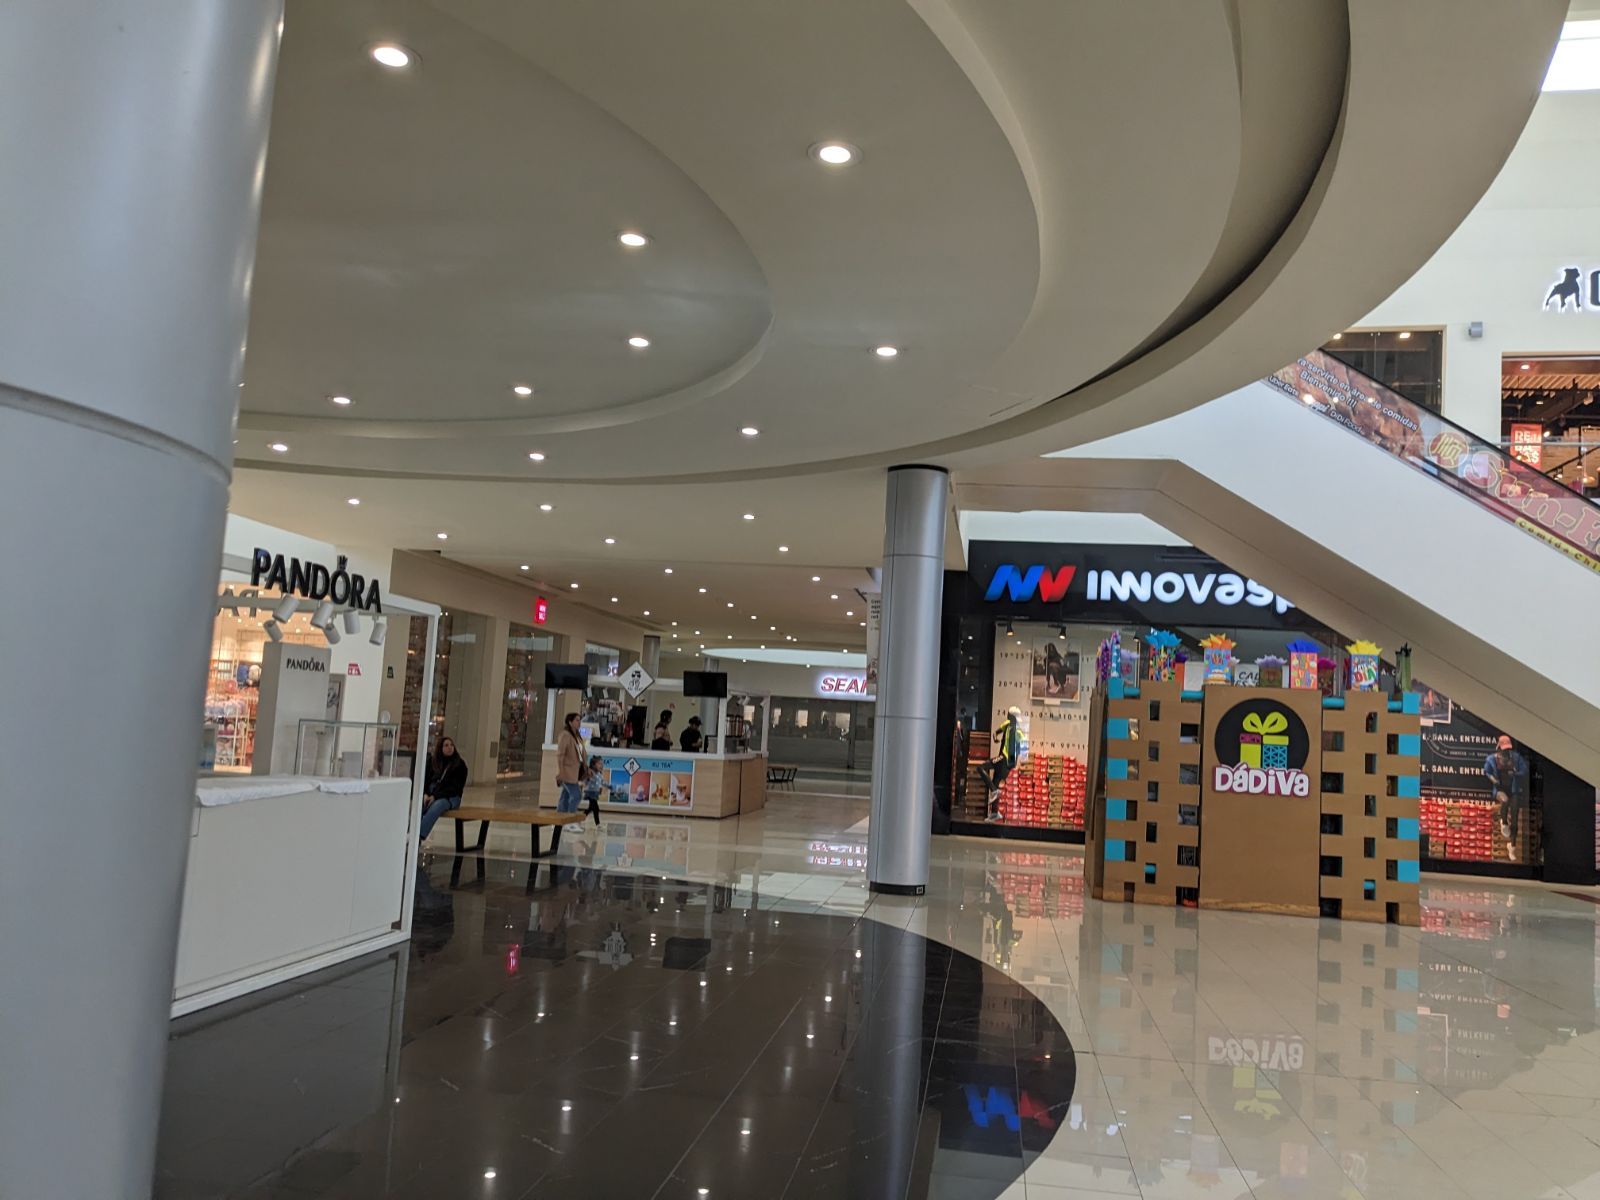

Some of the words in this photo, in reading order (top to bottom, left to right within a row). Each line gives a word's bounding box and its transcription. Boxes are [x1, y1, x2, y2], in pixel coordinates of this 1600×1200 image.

[1299, 369, 1346, 402] Bienvenido
[1307, 360, 1339, 386] servirte
[1339, 381, 1350, 392] en
[1382, 405, 1419, 432] comidas
[1463, 451, 1600, 560] Sun-F
[1517, 519, 1570, 555] Comida
[1573, 552, 1600, 574] Chi
[1459, 767, 1486, 776] ENTRE
